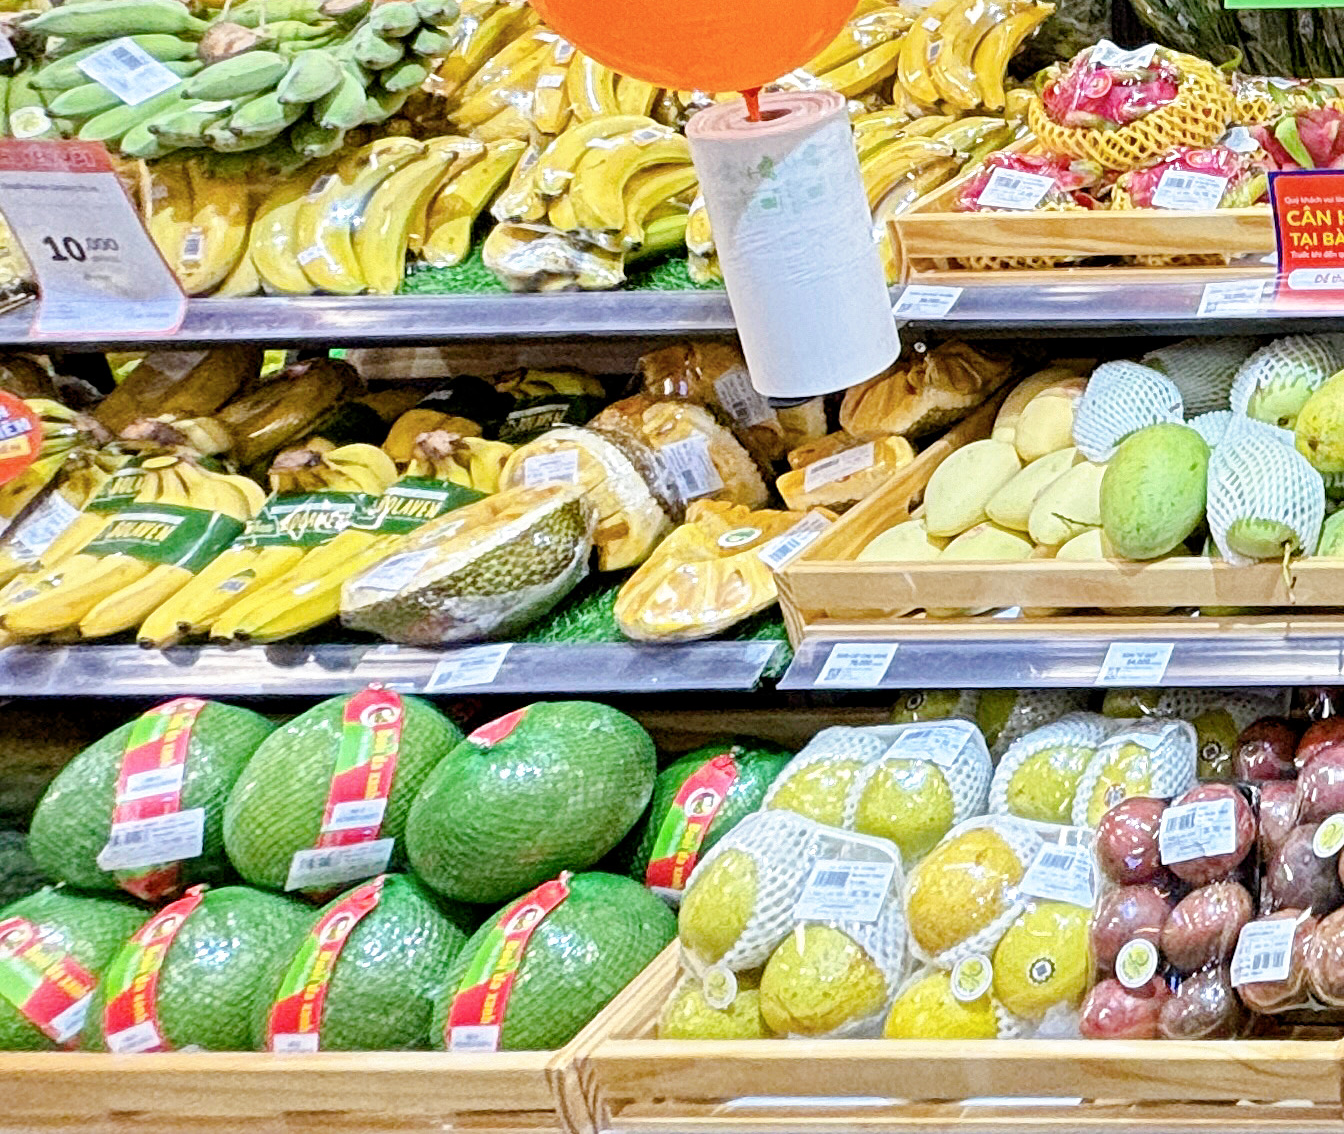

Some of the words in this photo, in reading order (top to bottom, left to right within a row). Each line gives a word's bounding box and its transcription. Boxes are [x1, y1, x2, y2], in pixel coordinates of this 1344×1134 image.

[1286, 205, 1331, 227] CÂN
[43, 236, 86, 262] 10
[1289, 232, 1318, 250] TẠI
